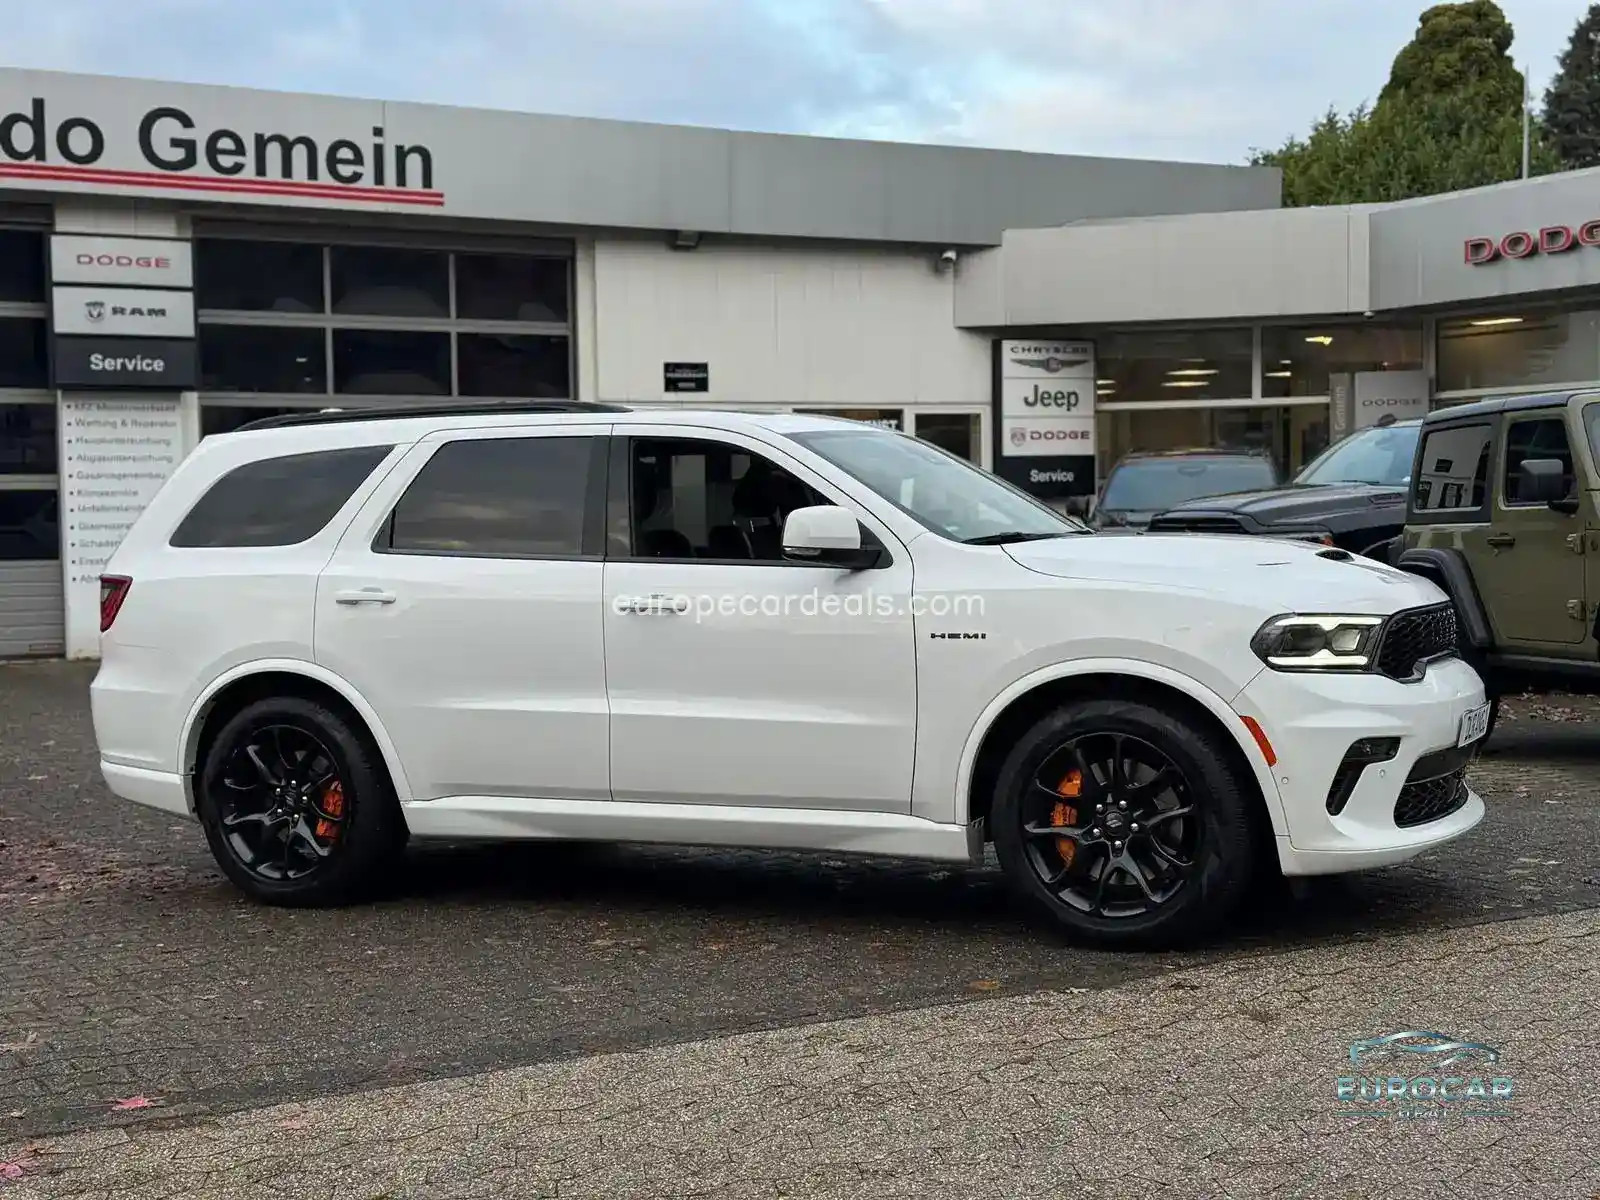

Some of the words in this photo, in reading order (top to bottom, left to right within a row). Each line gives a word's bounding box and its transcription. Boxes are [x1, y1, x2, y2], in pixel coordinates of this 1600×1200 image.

[138, 106, 434, 189] Gemein
[76, 253, 171, 268] DODGE
[111, 306, 166, 317] RAM
[1010, 346, 1088, 354] CHRYSLER
[89, 353, 165, 372] Service
[1024, 384, 1079, 411] Jeep
[1362, 399, 1422, 407] DODGE
[1030, 430, 1090, 441] DODGE
[1030, 469, 1074, 482] Service
